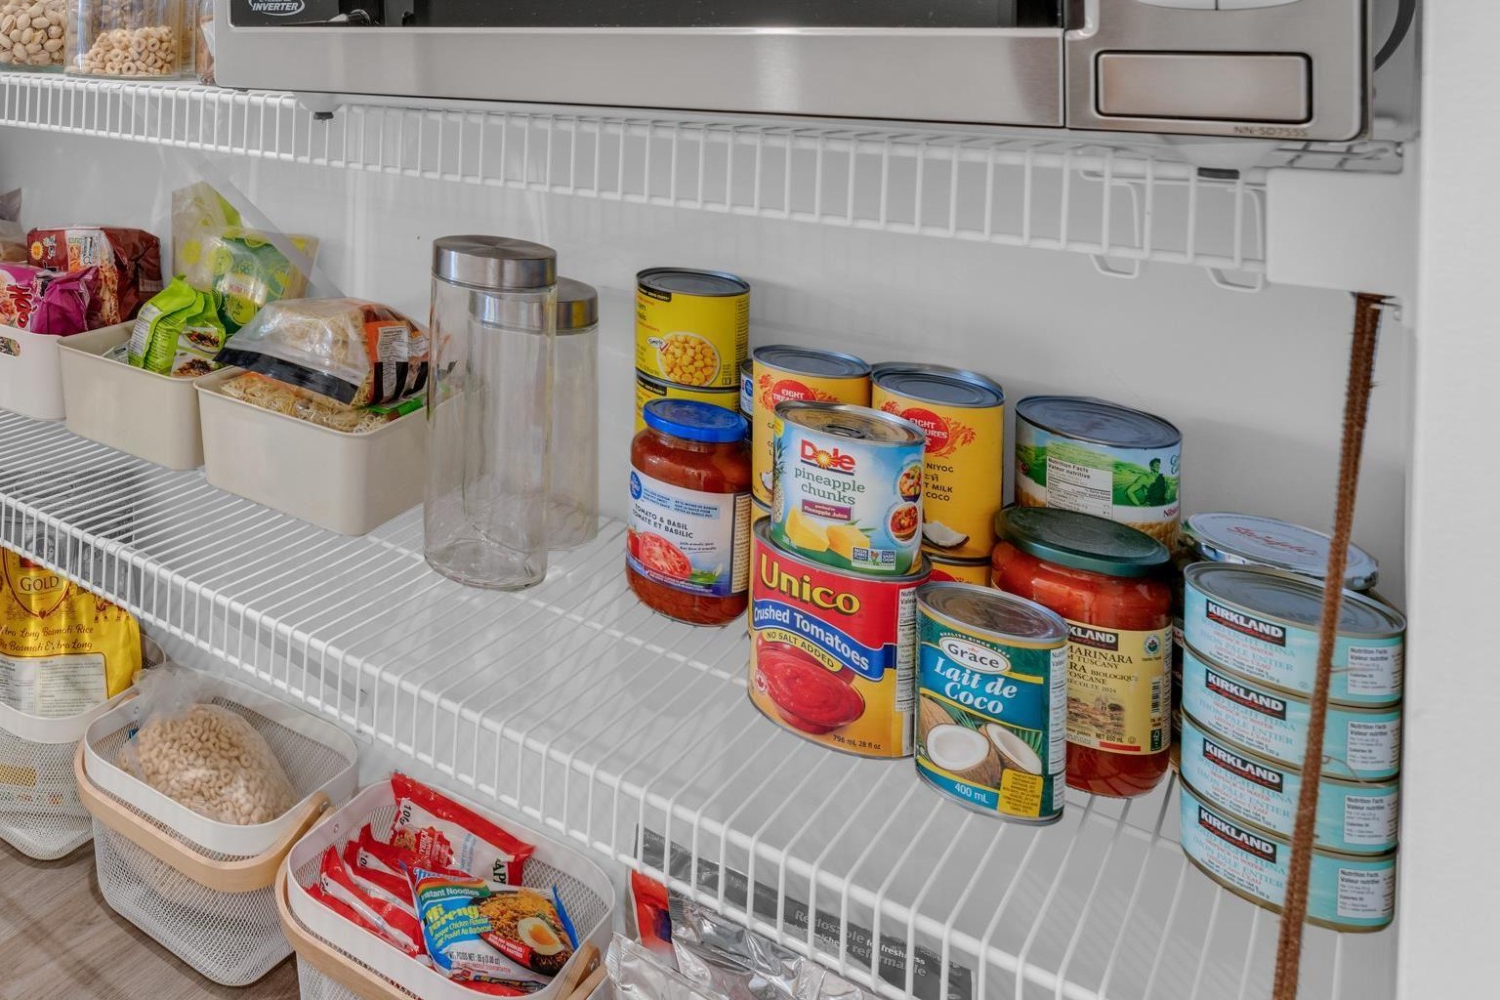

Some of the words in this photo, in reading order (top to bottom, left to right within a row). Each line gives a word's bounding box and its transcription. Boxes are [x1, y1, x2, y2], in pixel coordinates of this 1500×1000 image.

[252, 2, 298, 12] INVERTER
[781, 388, 804, 400] EIGHT
[800, 439, 856, 472] Dole
[1048, 456, 1072, 470] Nutrition
[1072, 464, 1089, 474] Facts
[794, 466, 866, 493] pineapple
[1048, 464, 1065, 473] Valeur
[1066, 468, 1091, 480] nutritive
[801, 481, 856, 506] chunks
[926, 491, 950, 502] COCO
[932, 484, 953, 493] MILK
[632, 510, 652, 526] TOMATE
[653, 522, 662, 530] ET
[664, 526, 694, 538] BASILIC
[634, 503, 657, 520] TOMATO
[660, 516, 664, 524] &
[666, 518, 688, 530] BASIL
[804, 506, 832, 519] Pineapple
[832, 510, 848, 520] Juice
[20, 576, 59, 592] GOLD
[760, 553, 860, 616] Unico
[1208, 602, 1283, 638] KIRKLAND
[20, 630, 40, 640] Long
[42, 626, 72, 636] Basmati
[76, 624, 94, 634] Rice
[754, 604, 790, 624] Crushed
[794, 612, 870, 672] Tomatoes
[10, 640, 44, 652] Basmati
[71, 640, 93, 651] Long
[766, 631, 776, 640] NO
[778, 632, 798, 646] SALT
[800, 640, 835, 668] ADDED
[948, 642, 1000, 670] Grace
[1077, 654, 1120, 670] TUSCANY
[934, 656, 982, 690] Lait
[984, 678, 1018, 699] de
[1068, 670, 1108, 686] OSCANE
[944, 681, 1004, 714] Coco
[1208, 672, 1284, 712] KIRKLAND
[832, 734, 846, 744] 796
[858, 740, 867, 748] 28
[1205, 742, 1281, 784] KIRKLAND
[954, 782, 972, 797] 400
[973, 791, 988, 804] mL
[1200, 809, 1274, 854] KIRKLAND
[446, 888, 480, 896] Noodles
